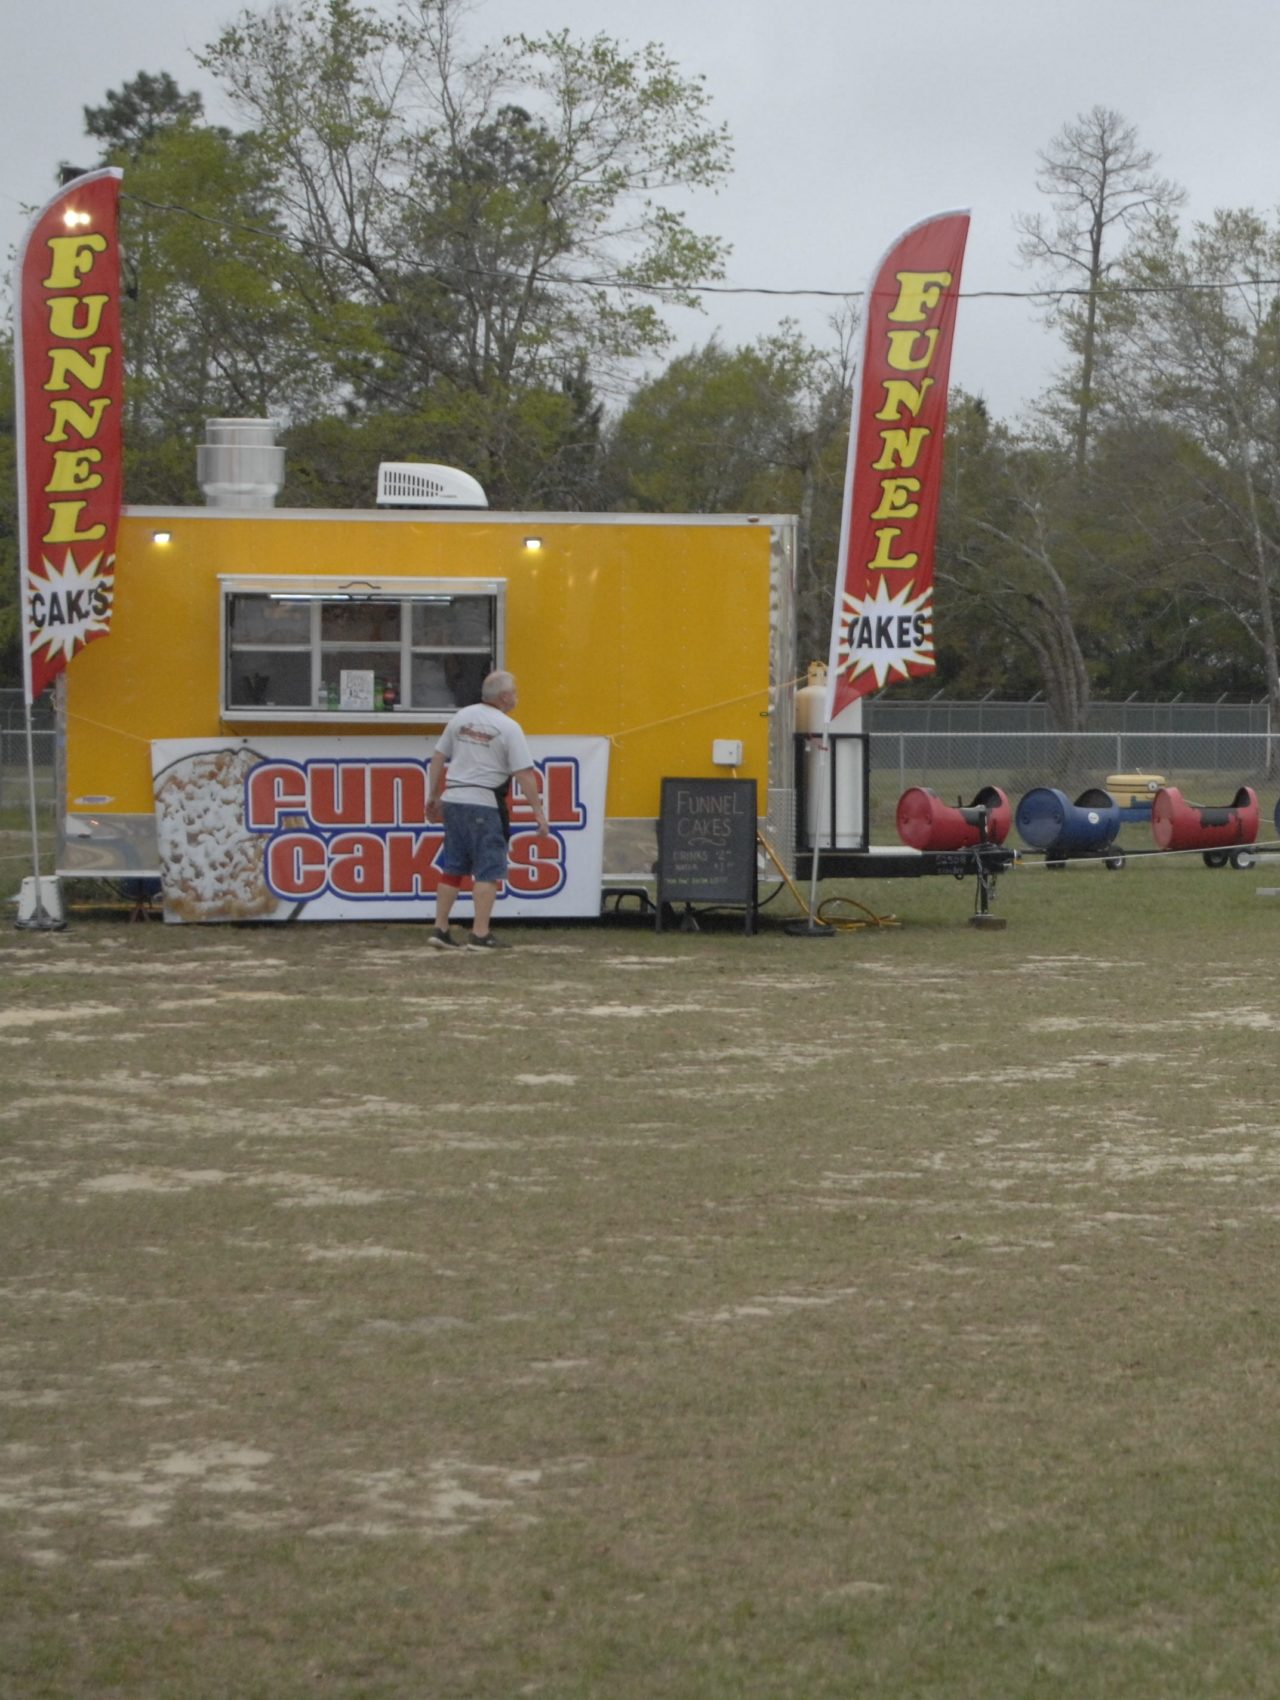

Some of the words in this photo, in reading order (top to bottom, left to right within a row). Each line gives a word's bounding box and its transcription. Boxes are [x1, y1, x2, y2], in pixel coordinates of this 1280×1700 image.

[42, 233, 112, 543] FUNNEL
[867, 271, 952, 570] FUNNEL
[31, 580, 109, 628] CAKS
[677, 790, 744, 815] FUNNEL
[677, 817, 732, 837] CAKES
[267, 830, 563, 897] CAKS
